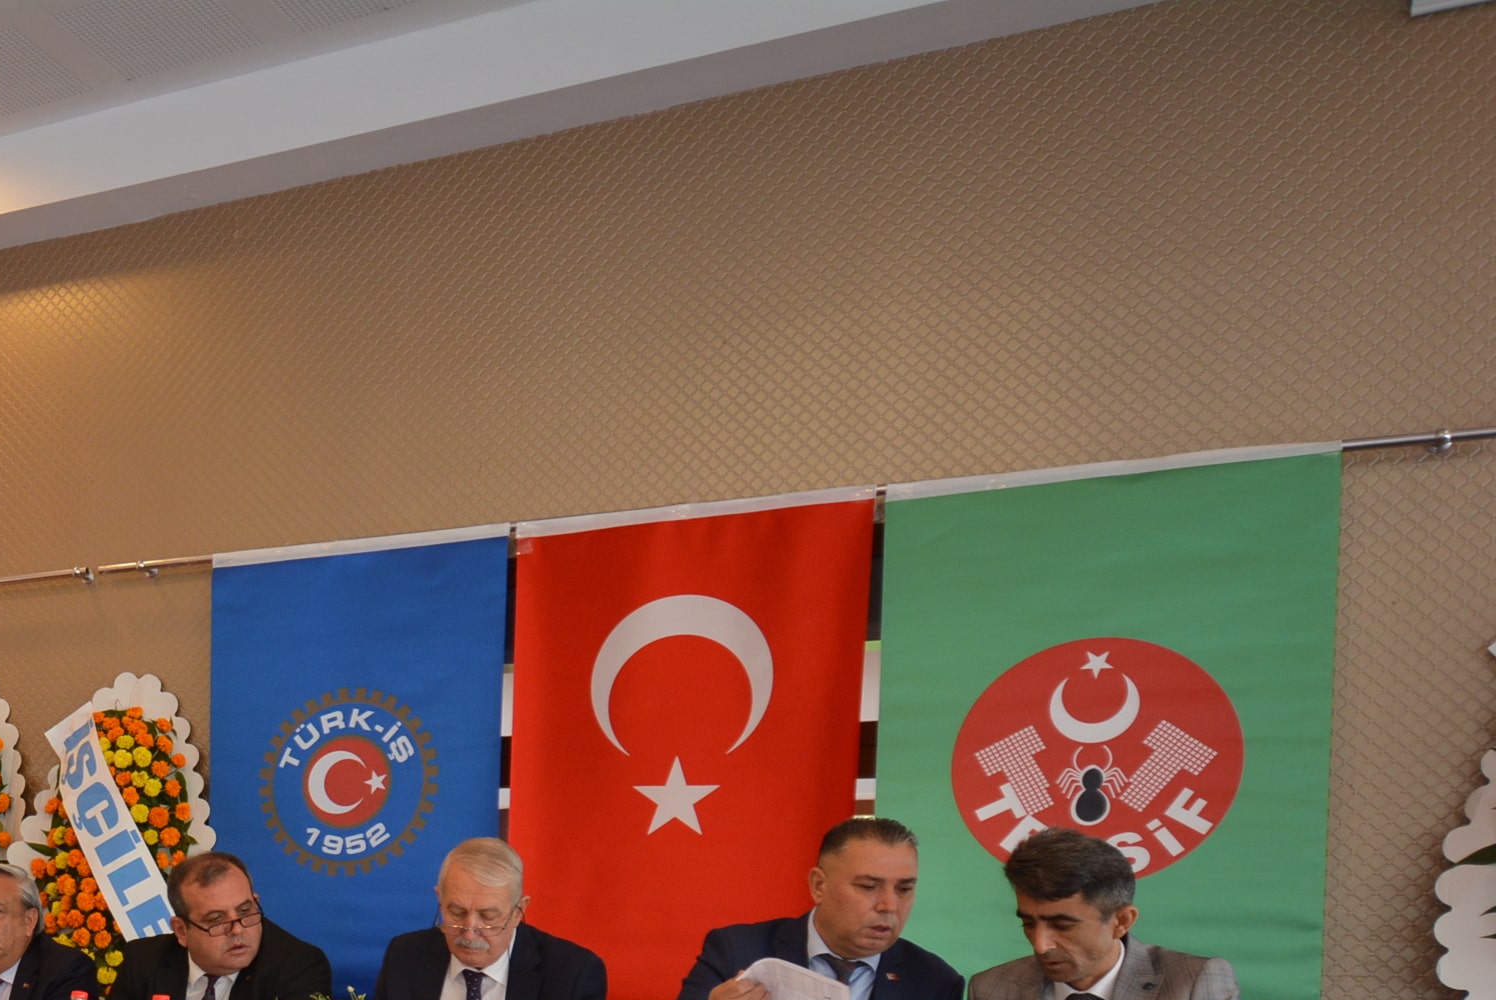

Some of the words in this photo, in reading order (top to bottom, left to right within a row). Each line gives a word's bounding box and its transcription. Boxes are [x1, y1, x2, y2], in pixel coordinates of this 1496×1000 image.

[278, 708, 415, 769] TÜRK-İŞ
[305, 822, 391, 856] 1952
[974, 781, 1214, 874] TESİF
